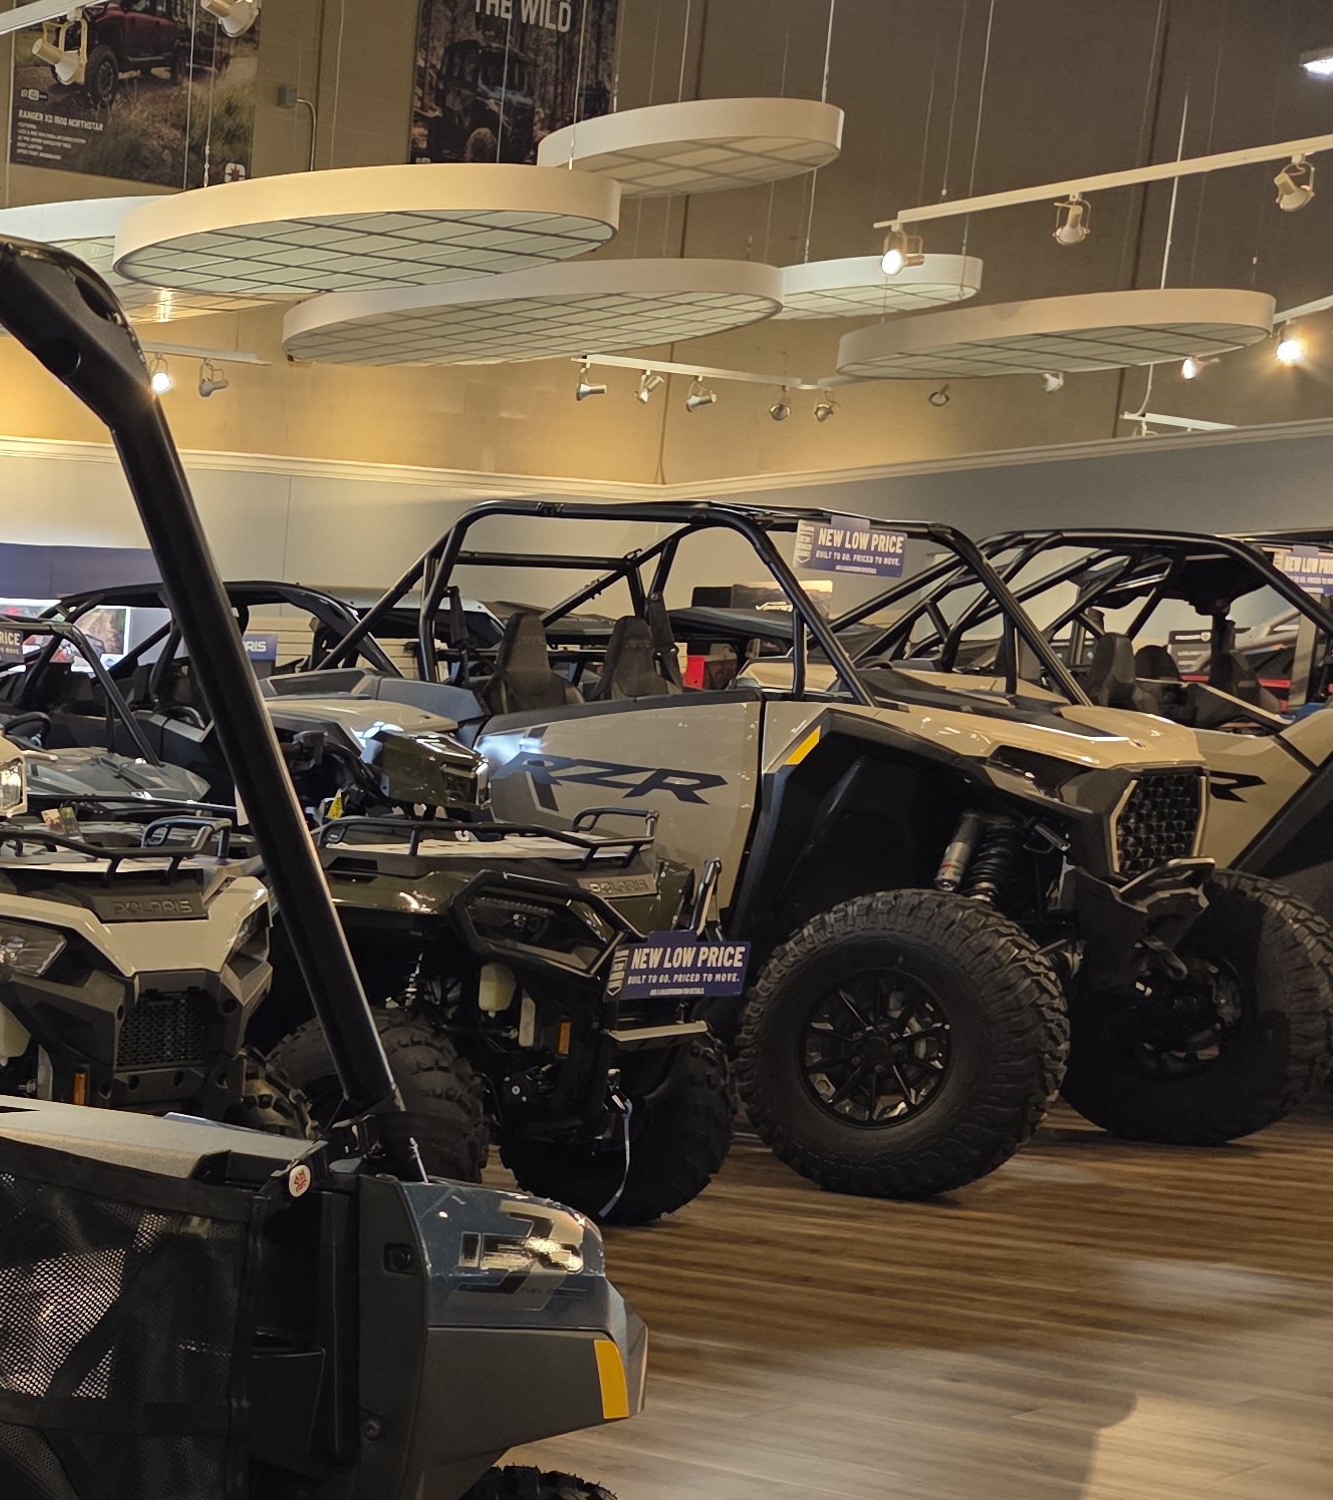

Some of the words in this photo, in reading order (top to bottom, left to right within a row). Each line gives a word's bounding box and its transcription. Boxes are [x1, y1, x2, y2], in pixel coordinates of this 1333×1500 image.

[520, 0, 572, 33] WILD
[18, 109, 44, 122] RANGER
[68, 118, 104, 132] NORTHSTAR
[817, 527, 844, 548] NEW
[845, 531, 870, 551] LOW
[871, 532, 904, 554] PRICE
[853, 554, 873, 564] PRICED
[490, 751, 728, 806] RZR
[589, 878, 649, 894] POLARIS
[113, 900, 193, 914] POLARIS
[631, 948, 664, 970] NEW
[663, 946, 697, 969] LOW
[697, 946, 746, 968] PRICE
[627, 975, 646, 985] BUILT
[648, 974, 657, 984] TO
[673, 974, 700, 983] PRICED
[703, 973, 712, 982] TO
[715, 972, 740, 983] MOVE.
